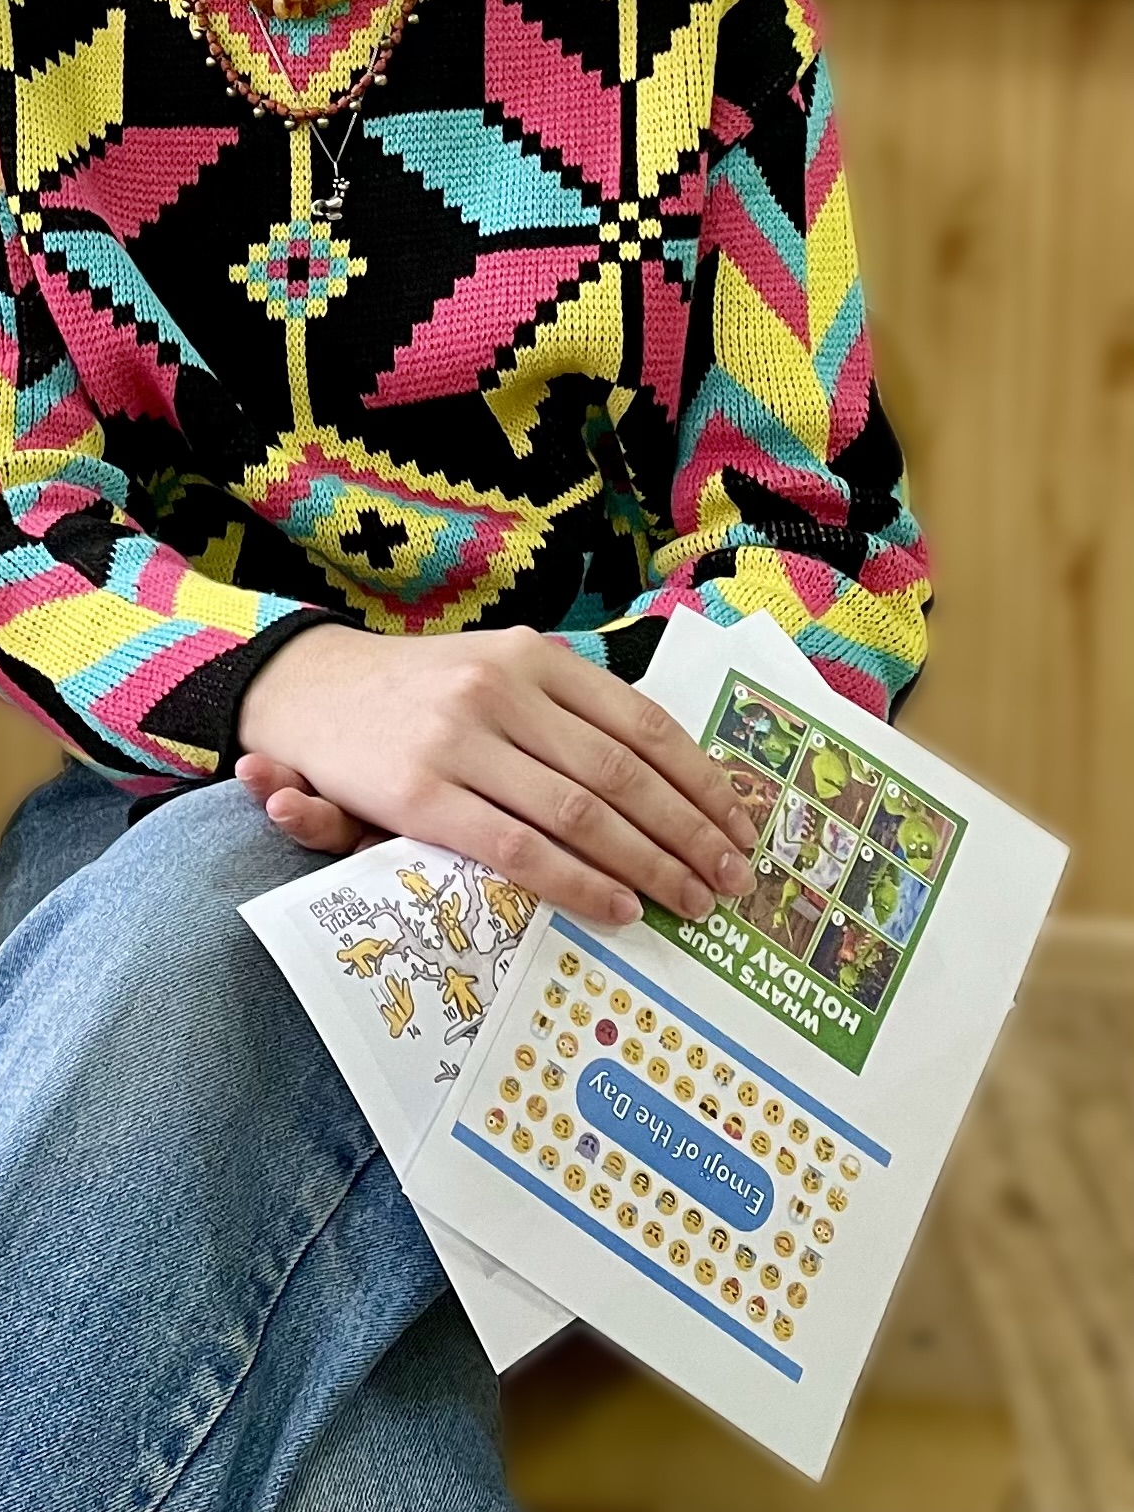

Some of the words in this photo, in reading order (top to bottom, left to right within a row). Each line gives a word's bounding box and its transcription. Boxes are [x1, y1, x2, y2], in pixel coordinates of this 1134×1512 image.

[319, 896, 372, 935] TREE
[487, 916, 502, 932] 16
[707, 913, 750, 955] MO
[338, 933, 354, 947] 19
[678, 920, 735, 976] YOUR
[738, 966, 820, 1036] WHAT'S
[749, 946, 862, 1036] HOLIDAY
[406, 1023, 422, 1040] 14
[442, 1005, 459, 1022] 10
[588, 1071, 634, 1121] Day
[635, 1105, 673, 1148] the
[671, 1137, 700, 1159] of
[699, 1152, 766, 1216] Emoji
